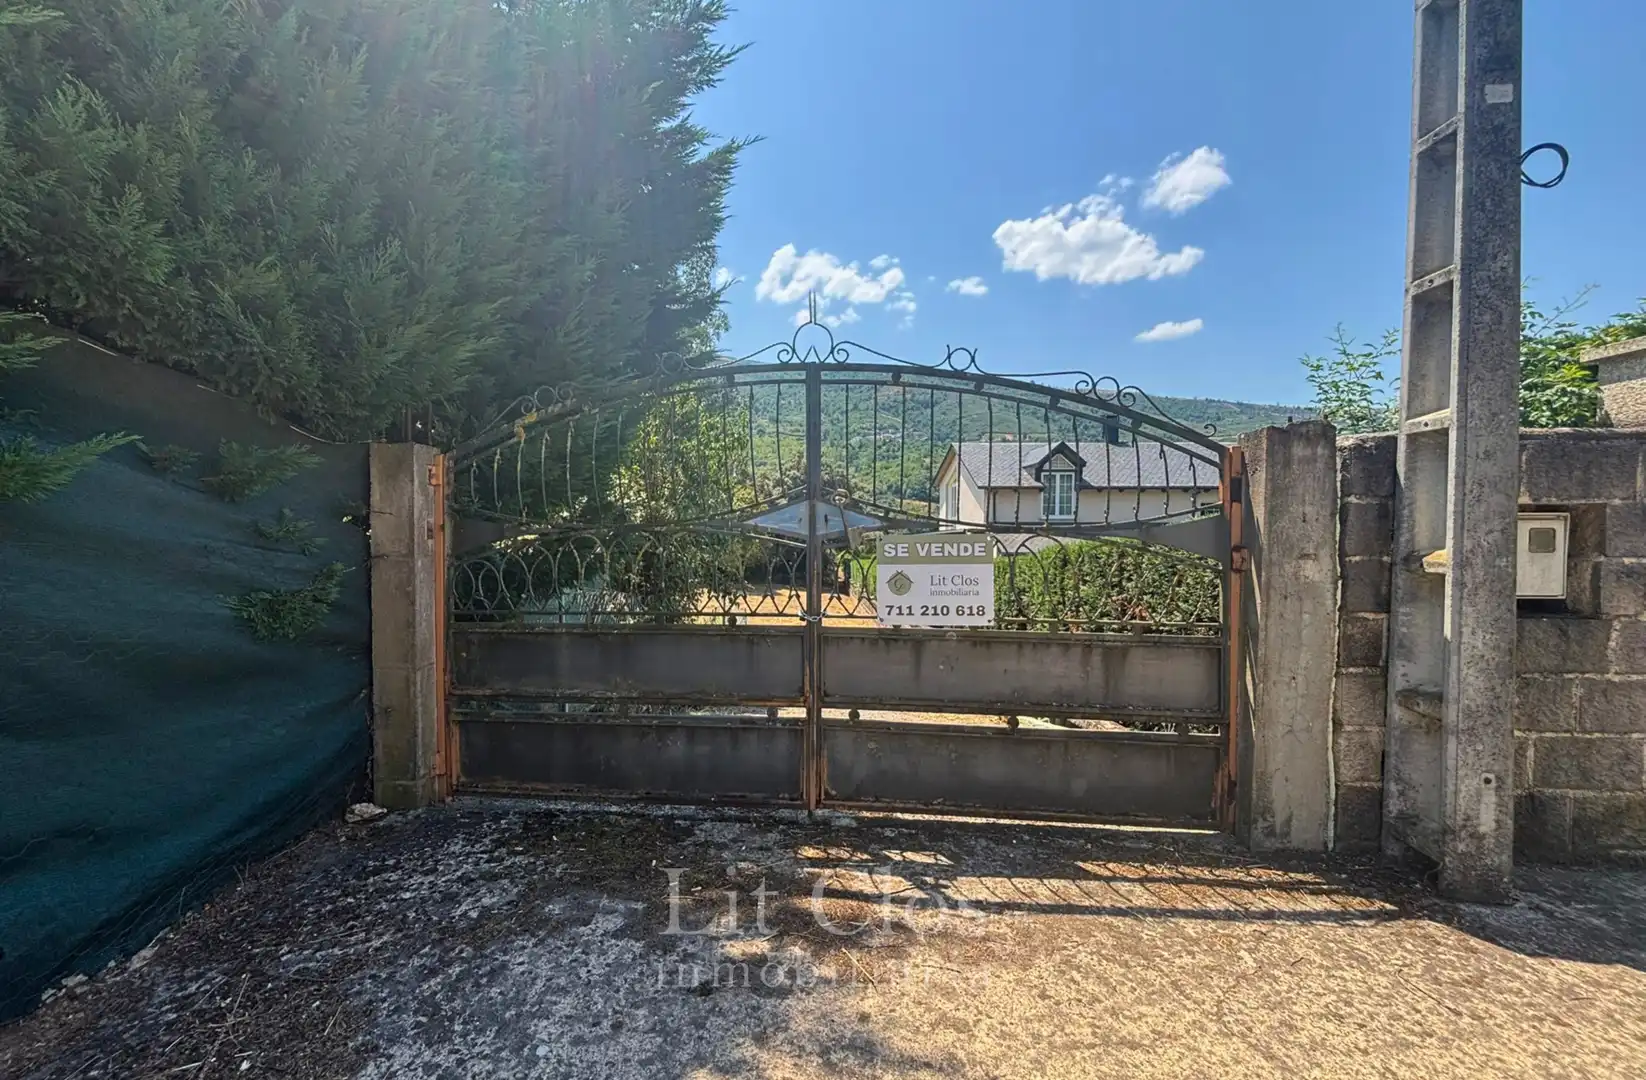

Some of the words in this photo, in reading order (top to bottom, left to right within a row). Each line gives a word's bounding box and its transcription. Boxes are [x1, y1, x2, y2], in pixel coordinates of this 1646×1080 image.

[883, 543, 909, 557] SE
[916, 542, 986, 556] VENDE
[930, 574, 948, 586] Lit
[951, 574, 979, 586] Clos
[929, 587, 980, 596] inmobiliaria
[885, 605, 915, 616] 711
[920, 605, 950, 616] 210
[956, 605, 986, 617] 618
